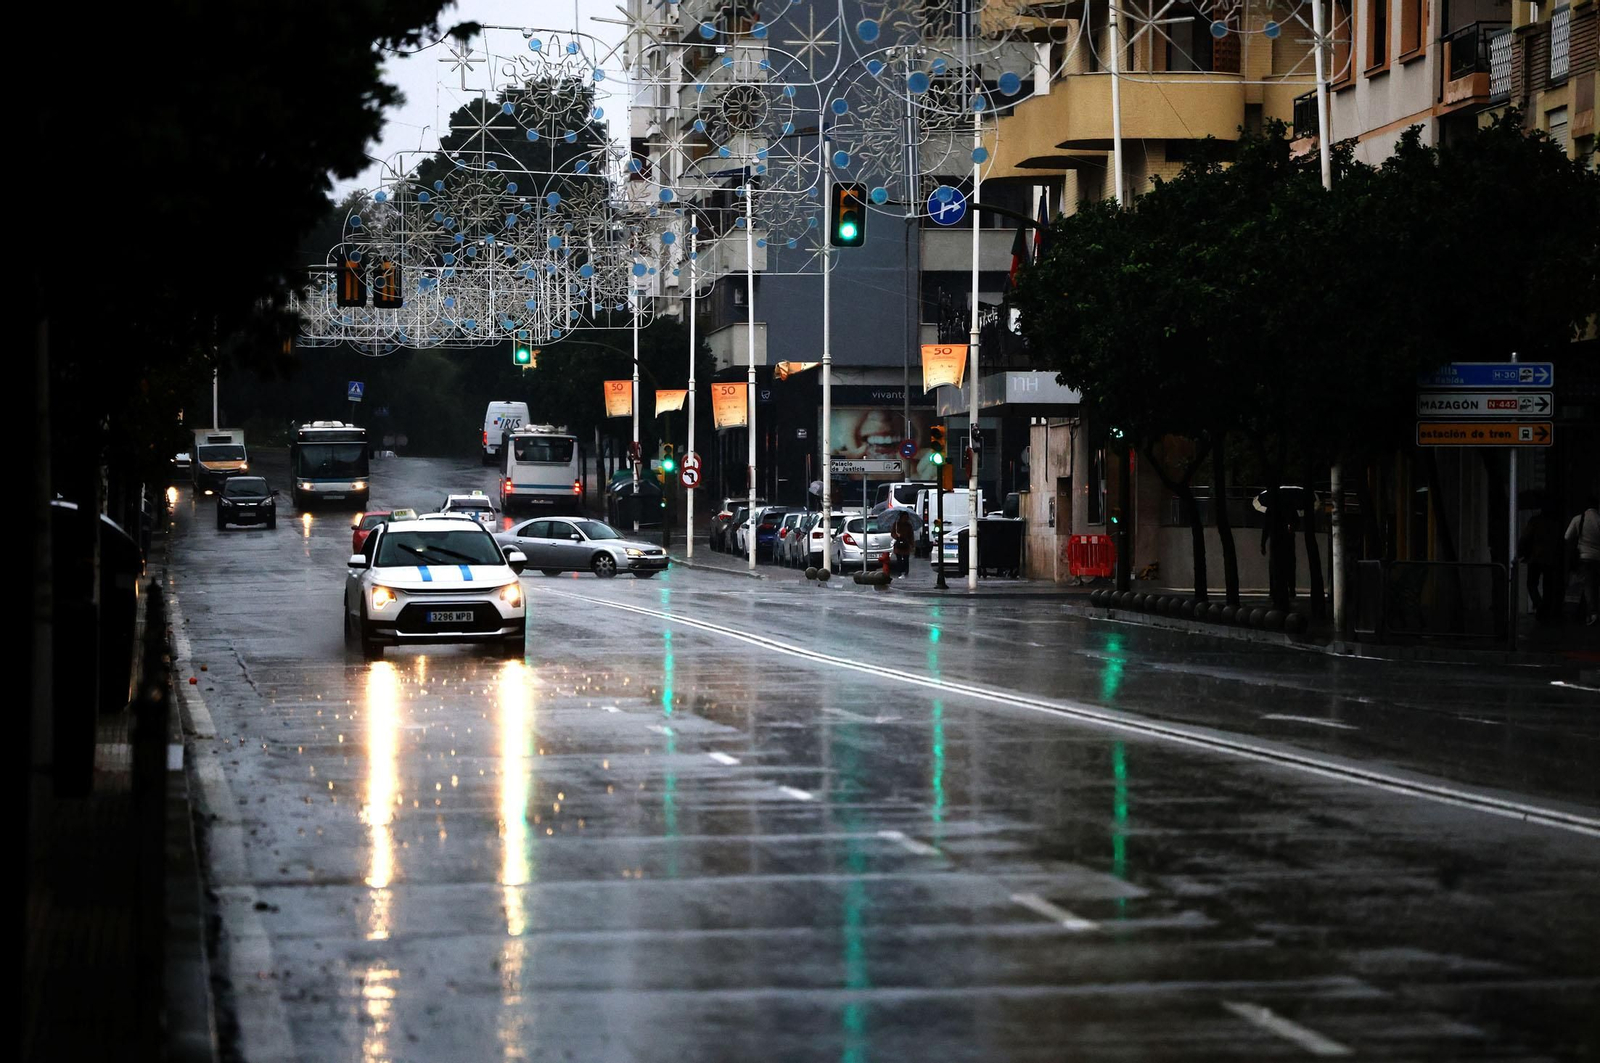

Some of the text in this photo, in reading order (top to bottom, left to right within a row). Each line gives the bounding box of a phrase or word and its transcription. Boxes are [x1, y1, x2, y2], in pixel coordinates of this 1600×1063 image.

[934, 347, 953, 356] 50
[612, 383, 624, 391] 50
[721, 386, 736, 395] 50
[1420, 399, 1479, 410] MAZAGÓN
[500, 418, 521, 429] IRIS
[1420, 429, 1511, 438] estación de tren
[432, 612, 472, 621] 3296 MPB
